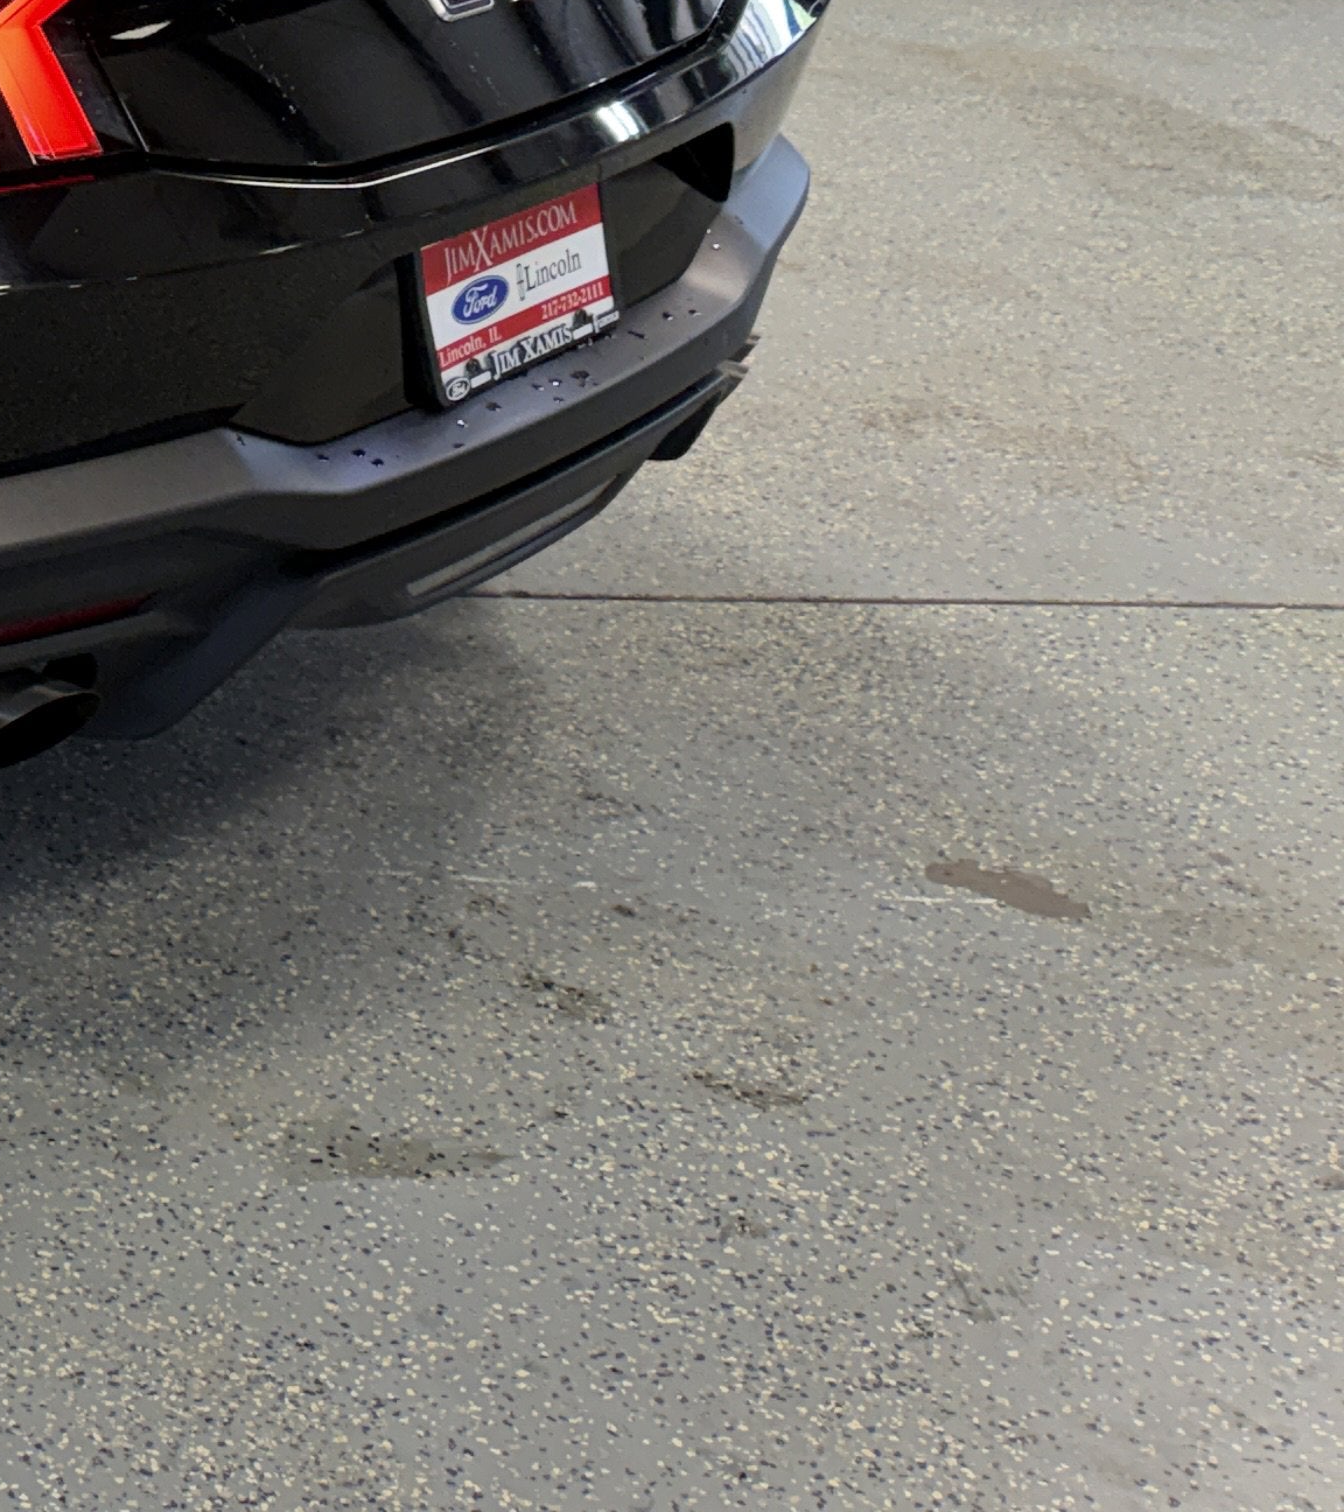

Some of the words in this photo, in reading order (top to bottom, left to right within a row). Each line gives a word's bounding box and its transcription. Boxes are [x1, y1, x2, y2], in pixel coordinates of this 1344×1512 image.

[523, 248, 582, 292] Lincoln
[462, 282, 499, 318] Ford
[488, 325, 503, 342] IL
[491, 349, 525, 381] JIM
[520, 324, 574, 363] XAMIS
